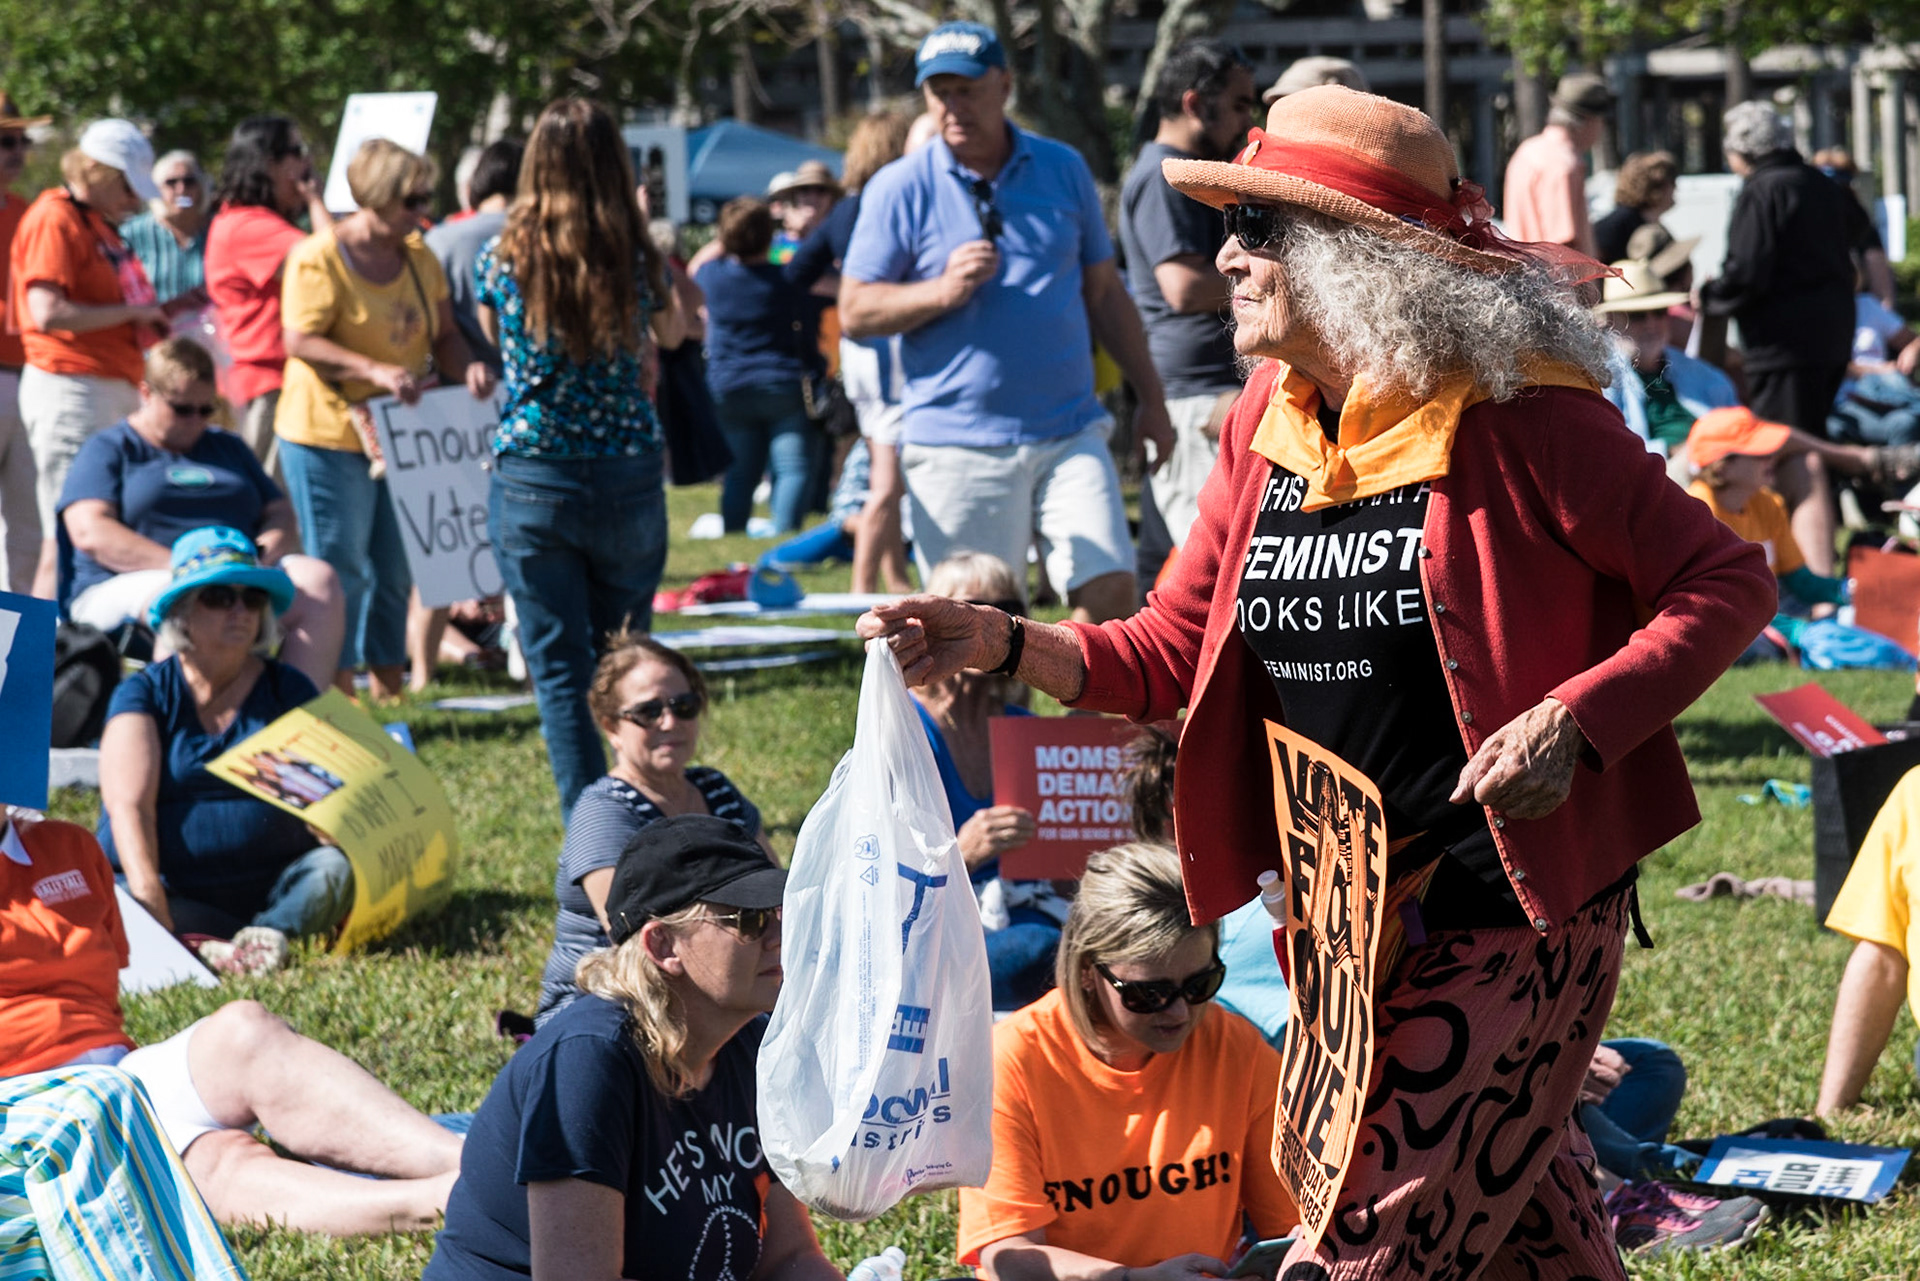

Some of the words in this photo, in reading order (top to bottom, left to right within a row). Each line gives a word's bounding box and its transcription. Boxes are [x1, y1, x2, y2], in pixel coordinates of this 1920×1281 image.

[1338, 588, 1424, 630] LIKE
[644, 1130, 705, 1215] HE'S
[701, 1172, 735, 1205] MY
[1043, 1151, 1231, 1212] ENOUGH!
[1299, 1149, 1327, 1198] TODAY
[1772, 1162, 1821, 1190] OUR
